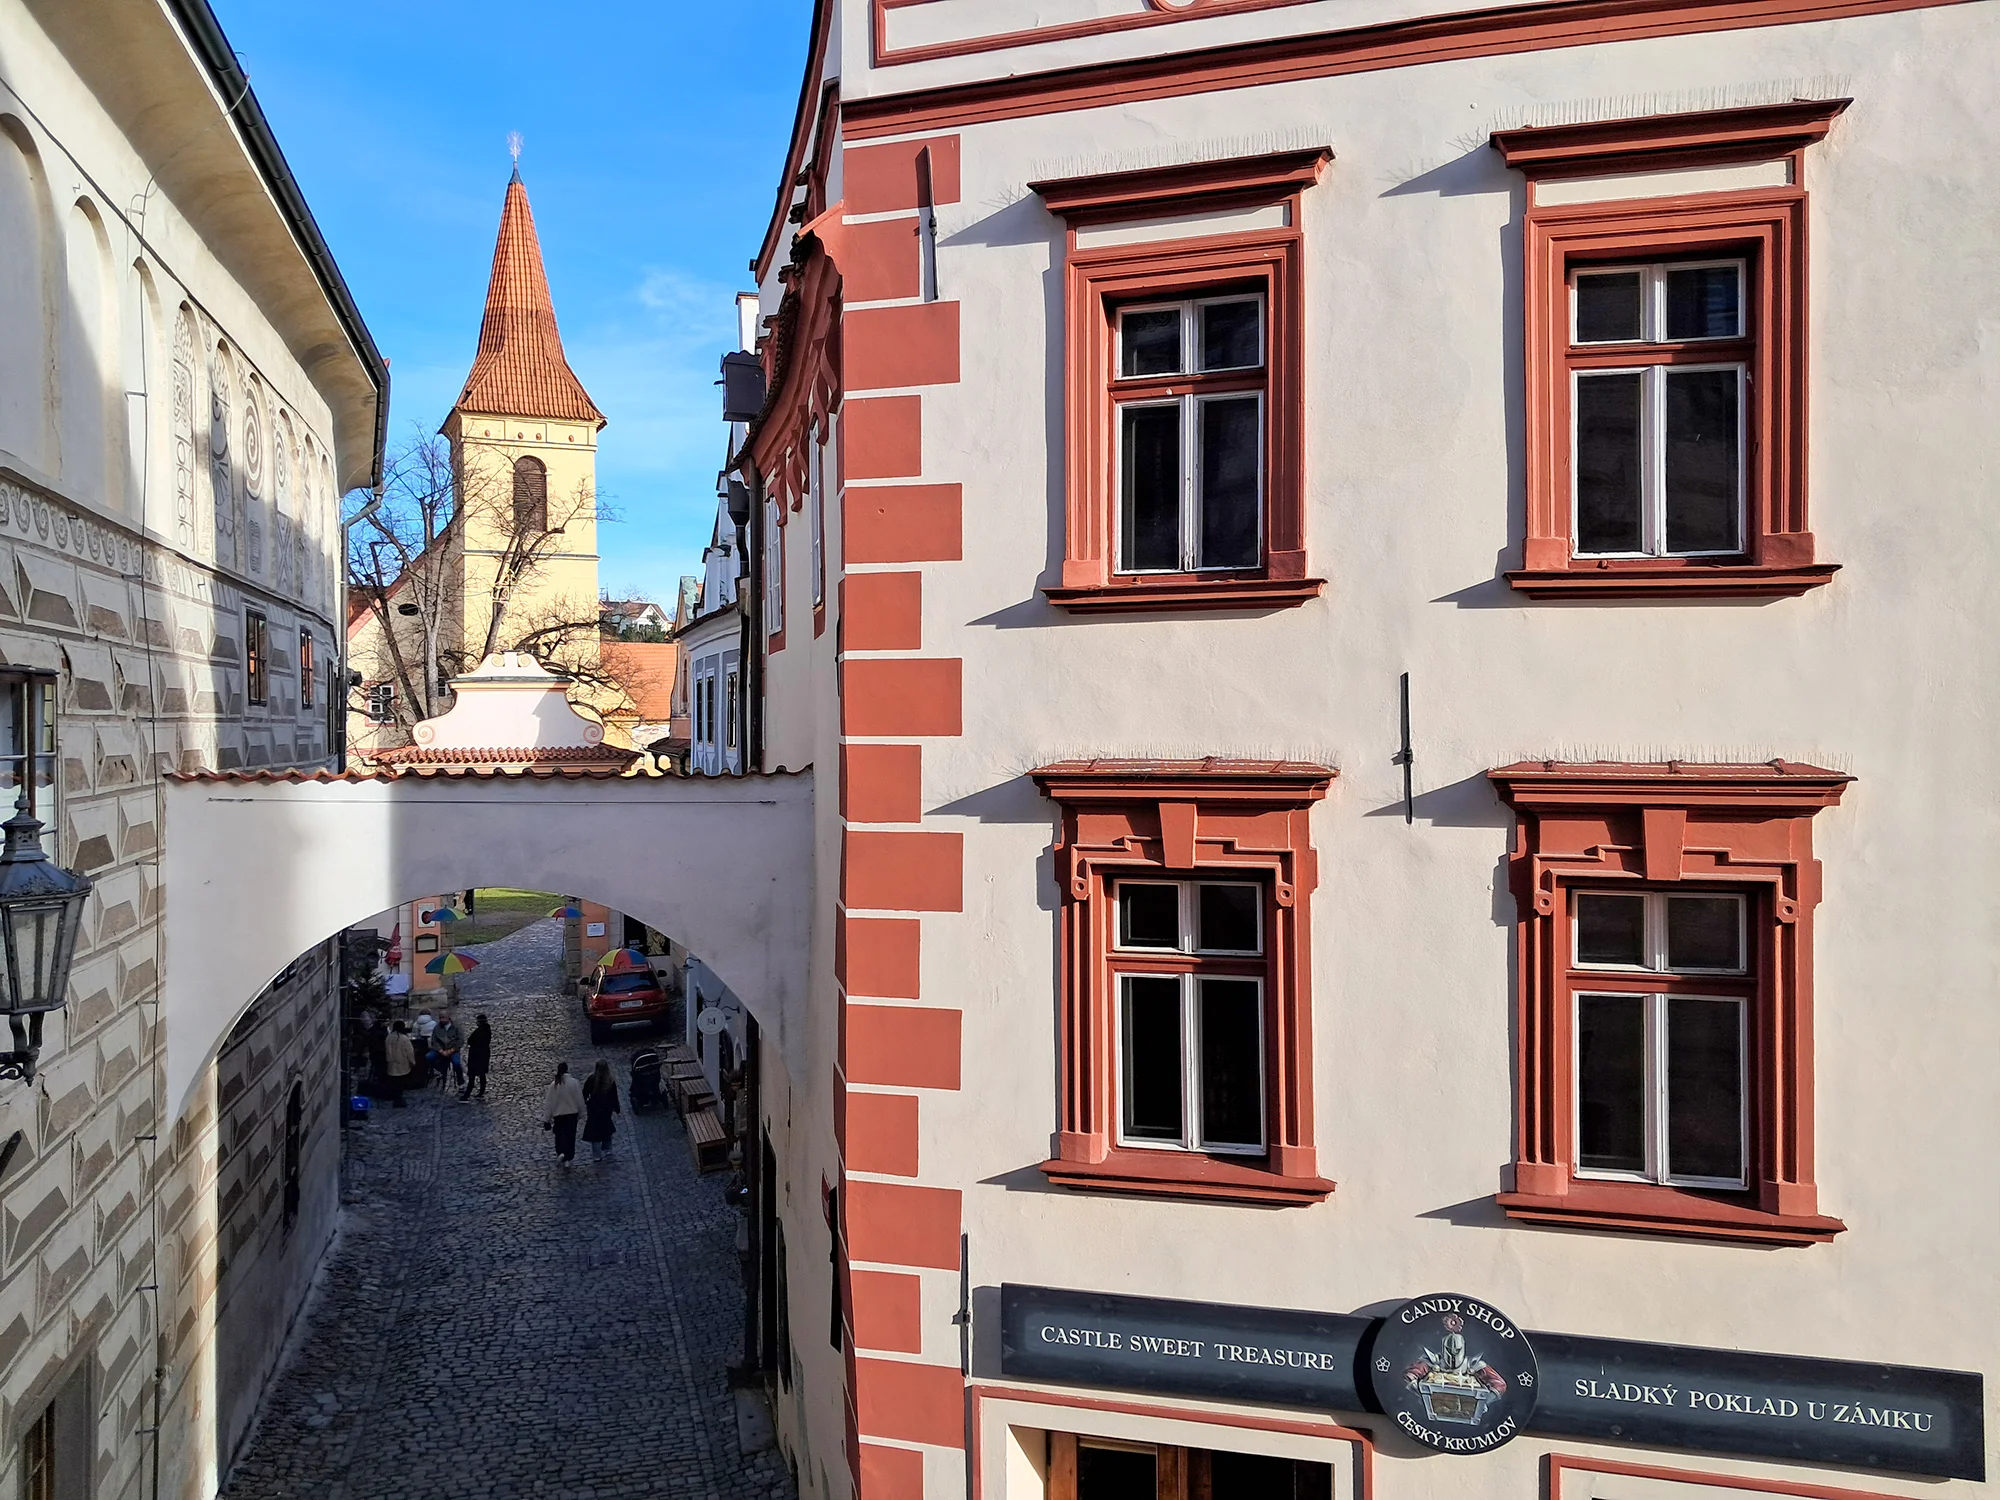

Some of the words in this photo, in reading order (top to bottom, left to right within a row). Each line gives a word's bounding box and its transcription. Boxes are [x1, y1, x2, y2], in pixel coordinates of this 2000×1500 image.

[1401, 1299, 1463, 1324] CANDY
[1466, 1303, 1515, 1339] SHOP
[1040, 1326, 1122, 1350] CASTLE
[1129, 1335, 1205, 1358] SWEET
[1213, 1343, 1335, 1371] TREASURE
[1575, 1378, 1679, 1407] SLADKÝ
[1688, 1391, 1799, 1418] POKLAD
[1807, 1401, 1827, 1421] U
[1833, 1401, 1933, 1432] ZÁMKU
[1396, 1410, 1443, 1447] ČESKÝ
[1445, 1415, 1518, 1451] KRUMLOV
